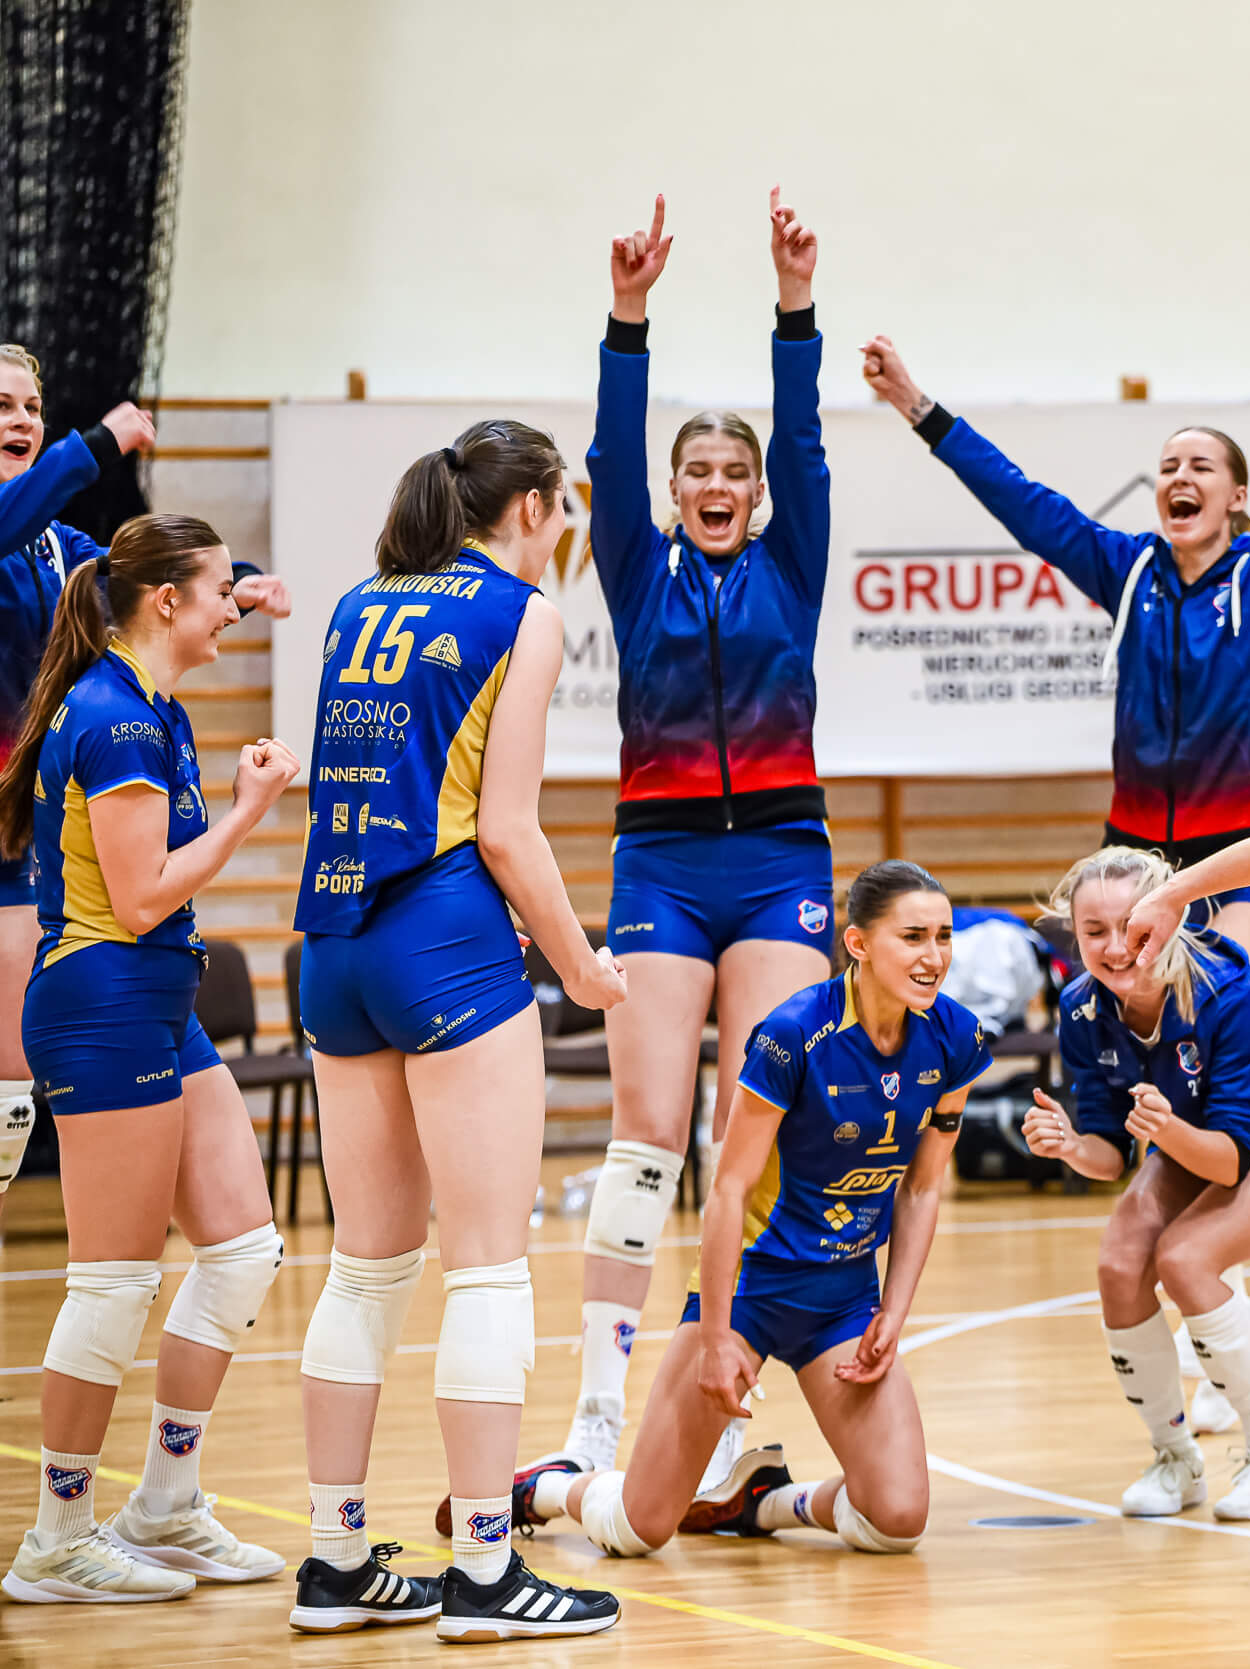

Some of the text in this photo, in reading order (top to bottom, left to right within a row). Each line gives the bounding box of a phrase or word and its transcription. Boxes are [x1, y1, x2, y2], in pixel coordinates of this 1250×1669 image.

[360, 574, 484, 600] JANKOWSKA
[855, 560, 1066, 613] GRUPA
[338, 604, 431, 685] 15
[445, 1007, 477, 1031] KROSNO
[136, 1068, 174, 1084] CUTLINE
[878, 1110, 896, 1145] 1
